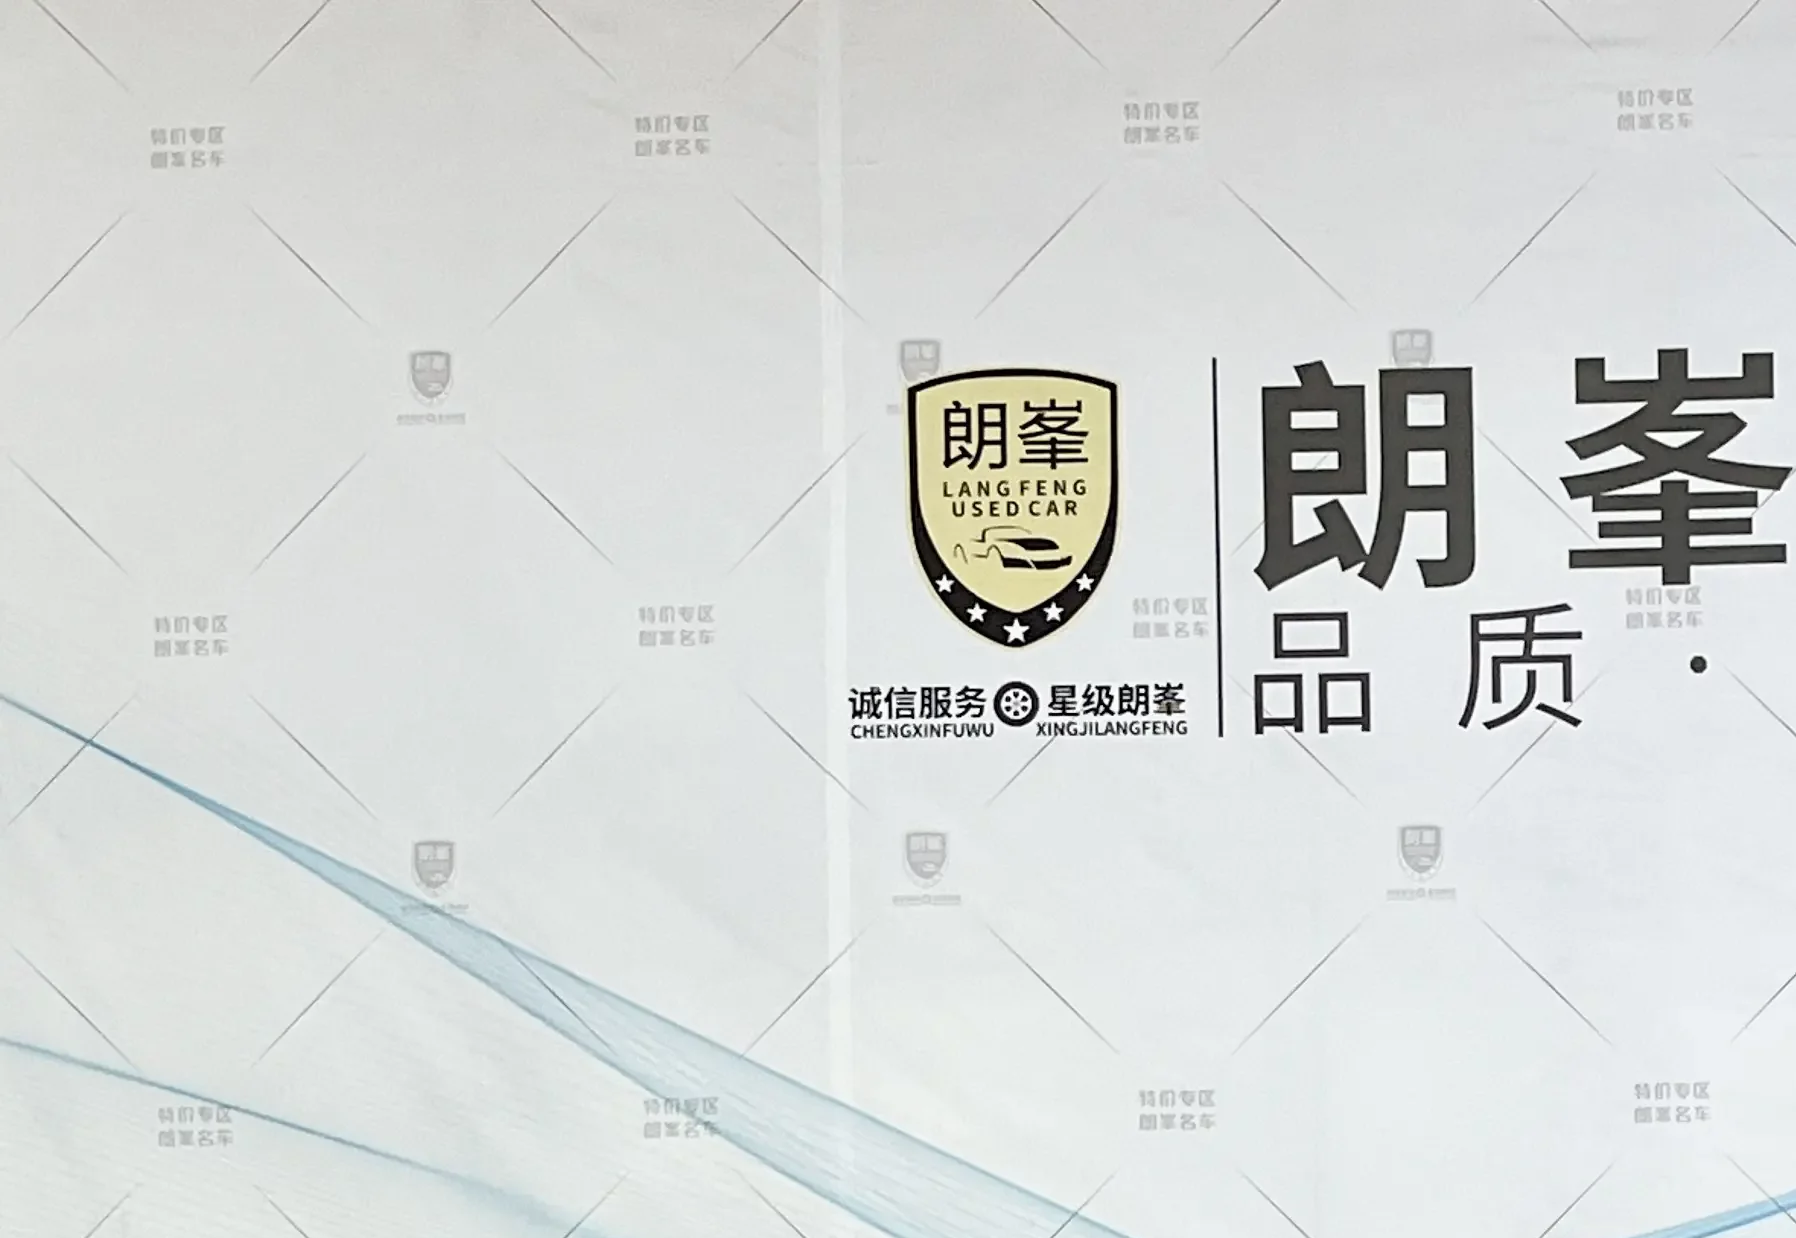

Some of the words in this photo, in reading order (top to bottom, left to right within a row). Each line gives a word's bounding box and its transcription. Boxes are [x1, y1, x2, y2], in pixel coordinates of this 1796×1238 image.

[943, 398, 1089, 470] 朗峯
[952, 500, 1020, 518] USED
[1028, 499, 1079, 517] CAR
[848, 685, 987, 720] 诚信服务
[1047, 682, 1186, 717] 星级朗峯
[849, 723, 995, 739] CHENGXINFUWU
[1035, 720, 1188, 738] XINGJILANGFENG
